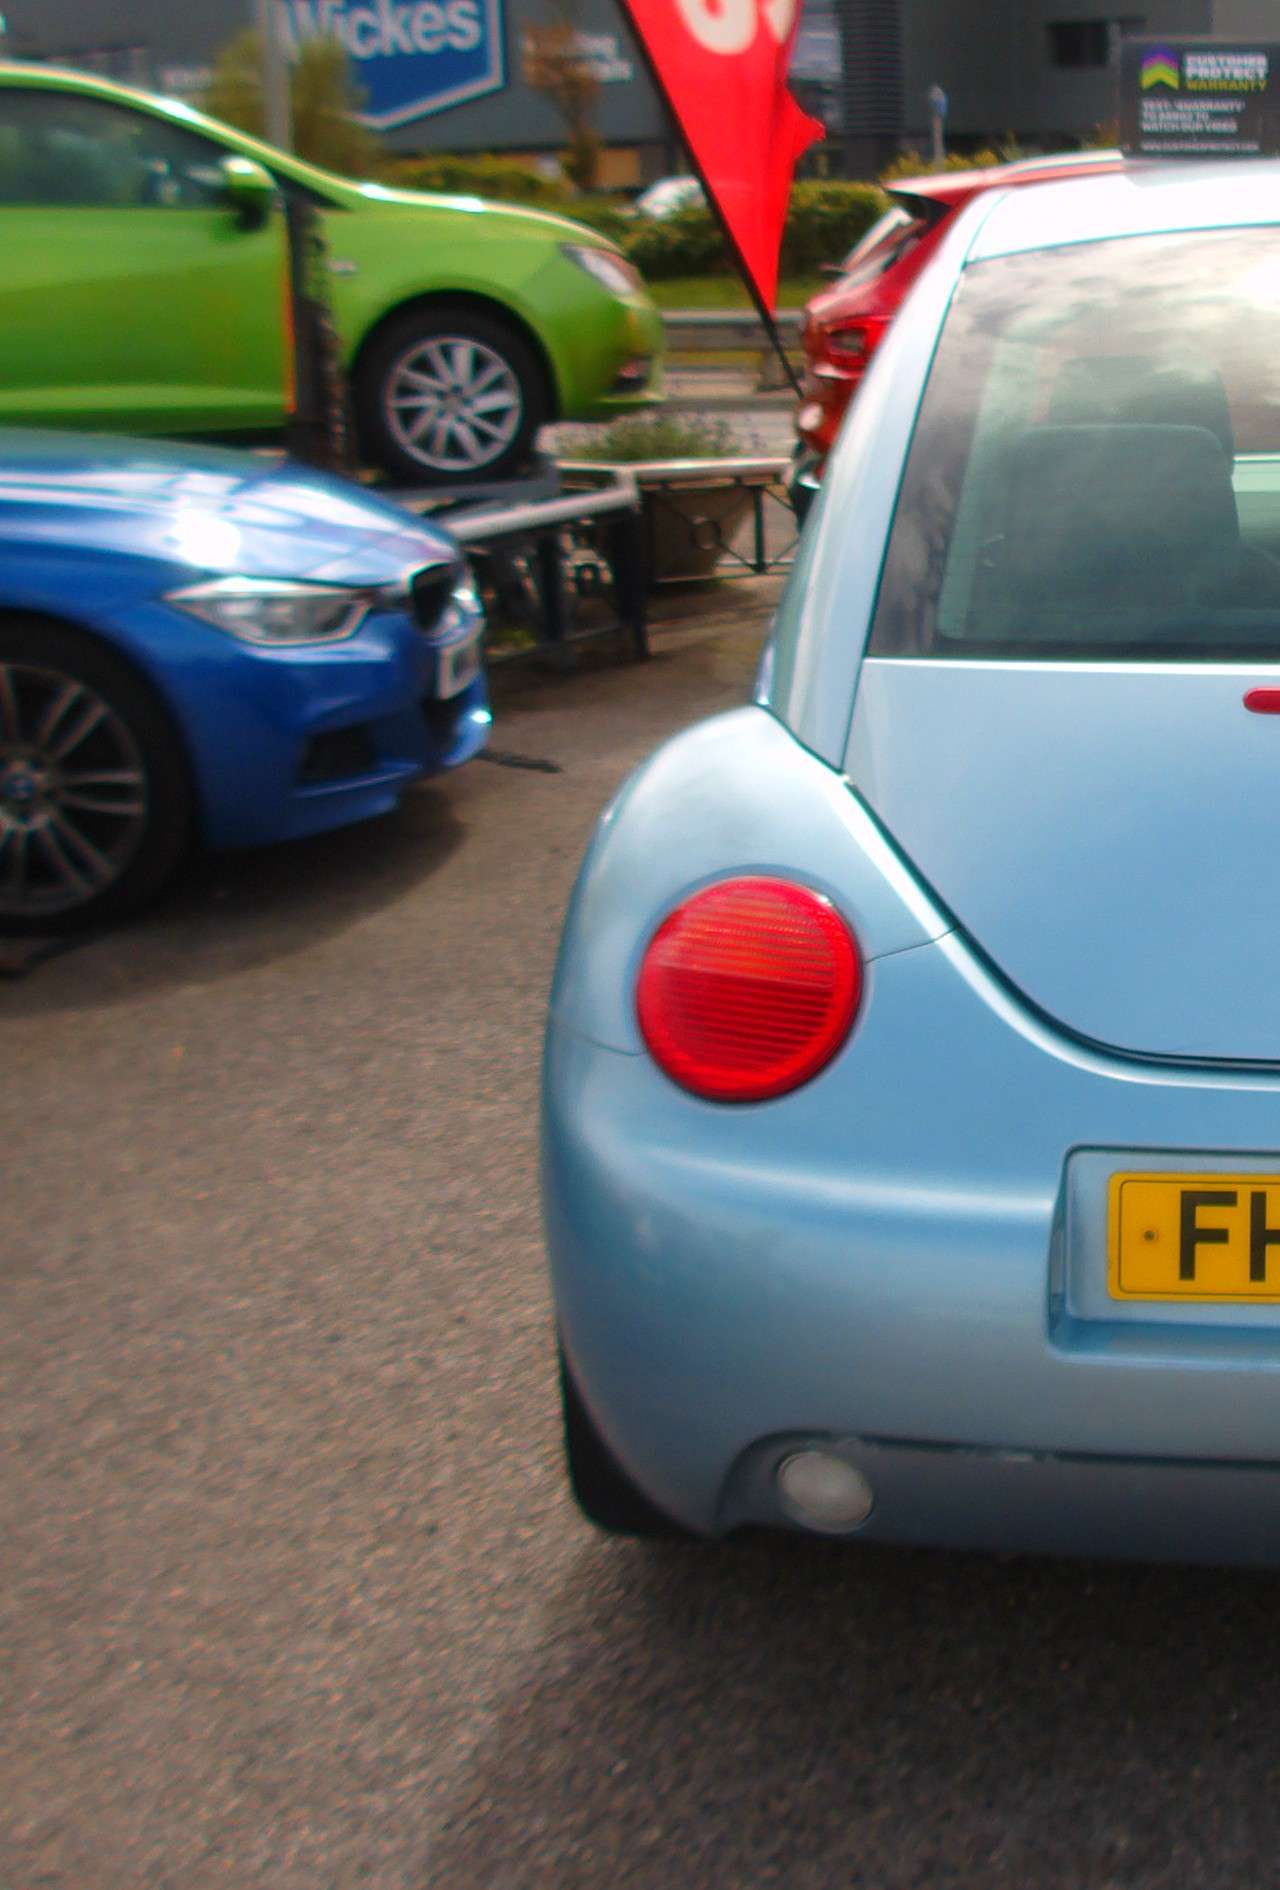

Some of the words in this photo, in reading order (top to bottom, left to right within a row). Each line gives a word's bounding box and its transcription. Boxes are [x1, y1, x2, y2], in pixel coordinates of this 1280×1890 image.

[276, 0, 482, 63] Wickes
[1184, 67, 1267, 80] PROTECT
[1184, 80, 1268, 91] WARRANTY
